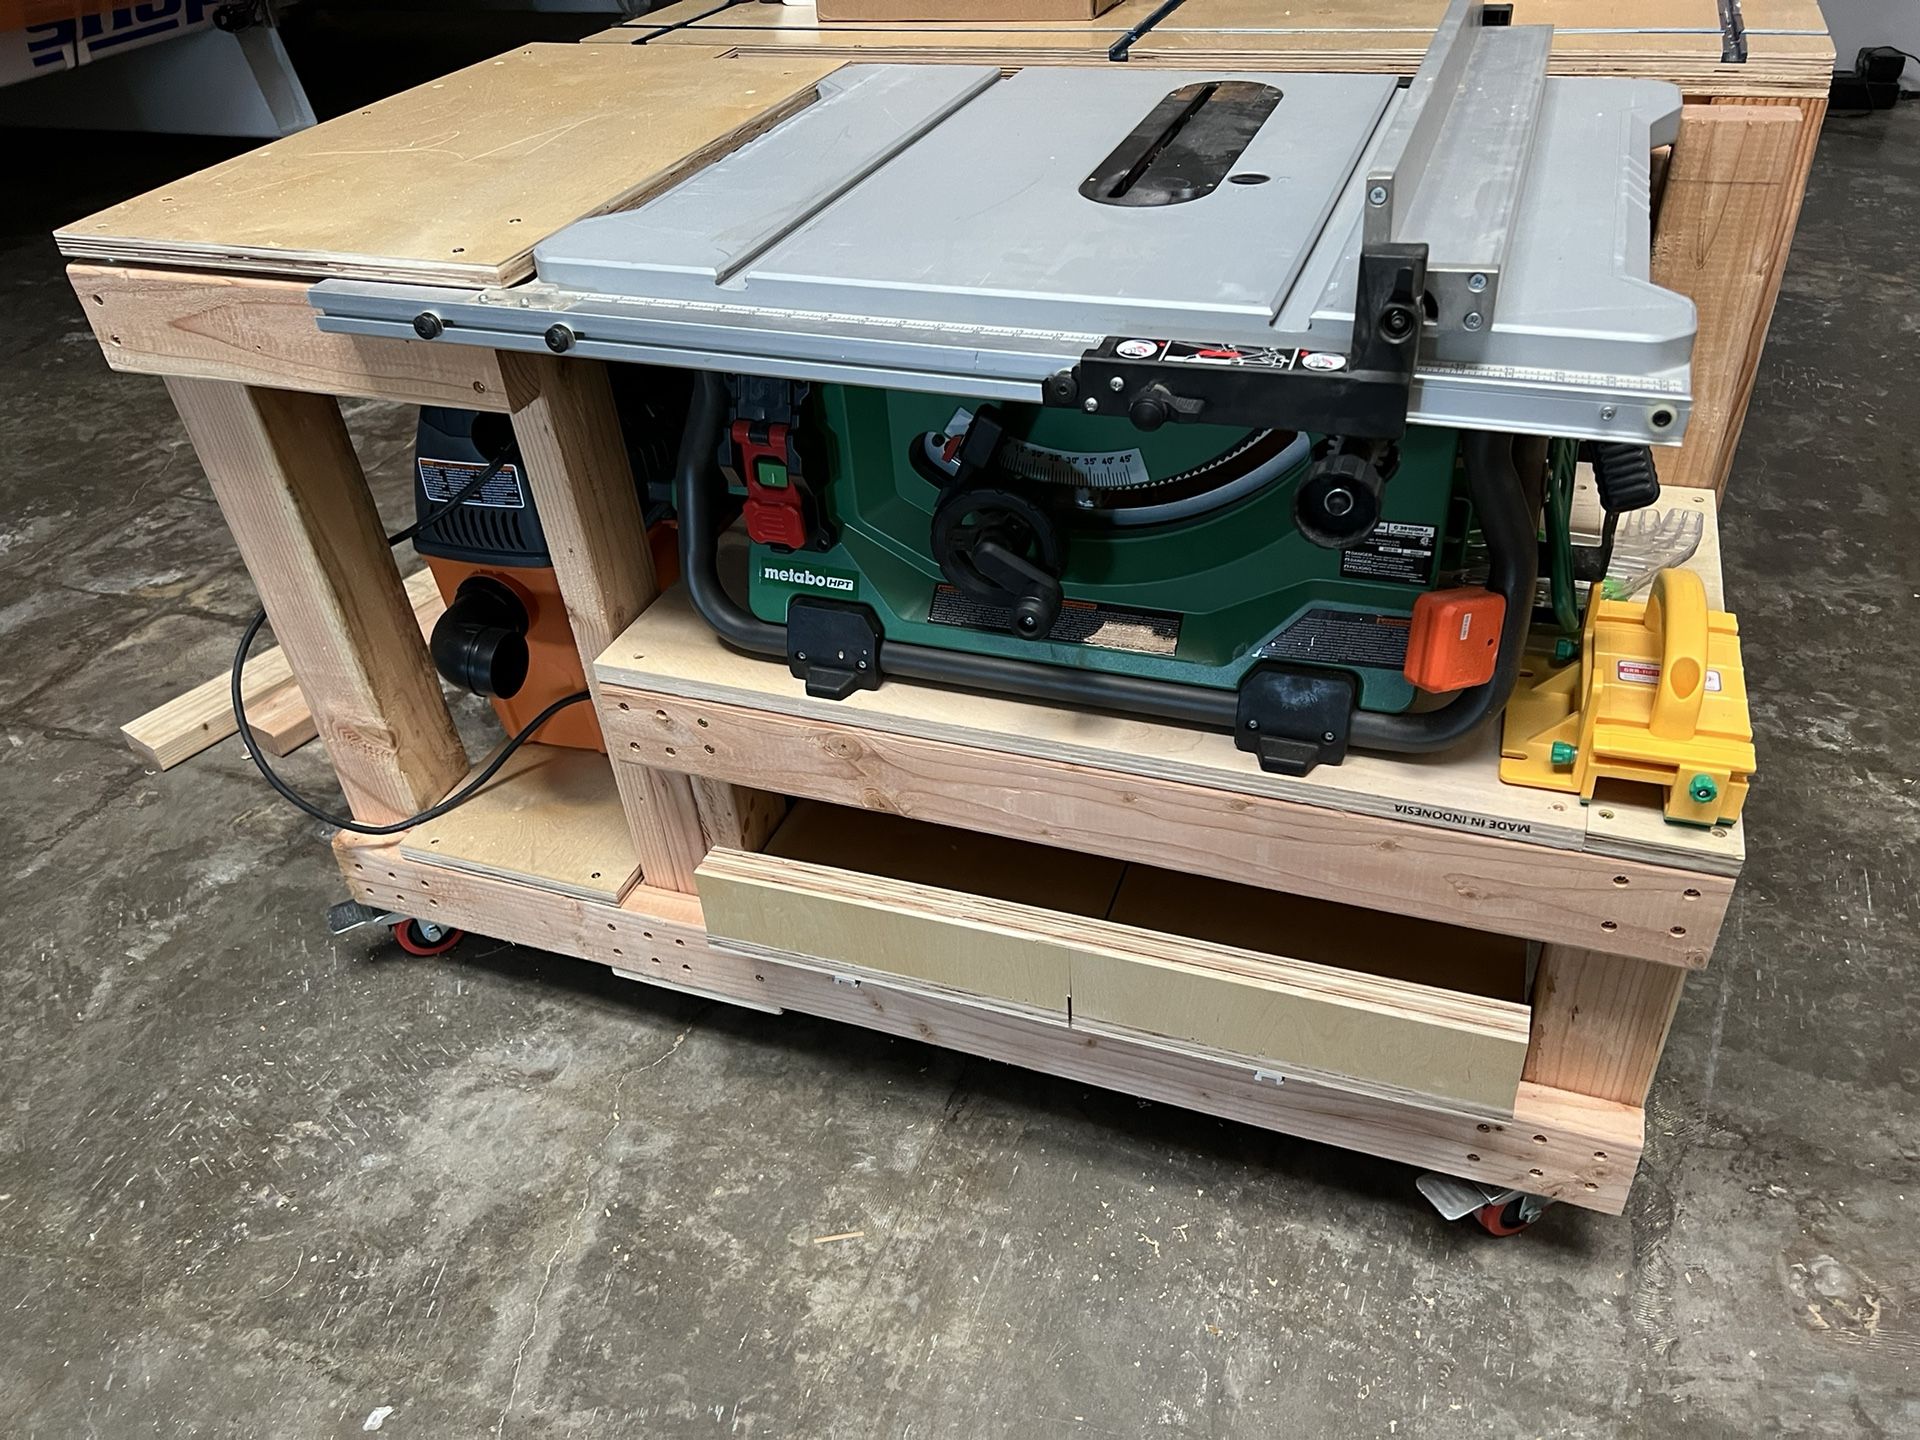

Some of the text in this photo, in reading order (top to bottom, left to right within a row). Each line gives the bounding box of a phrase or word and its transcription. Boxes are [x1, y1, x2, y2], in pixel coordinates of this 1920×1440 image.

[764, 567, 853, 590] metabo HPT
[1394, 804, 1531, 833] MADE IN INDONESIA
